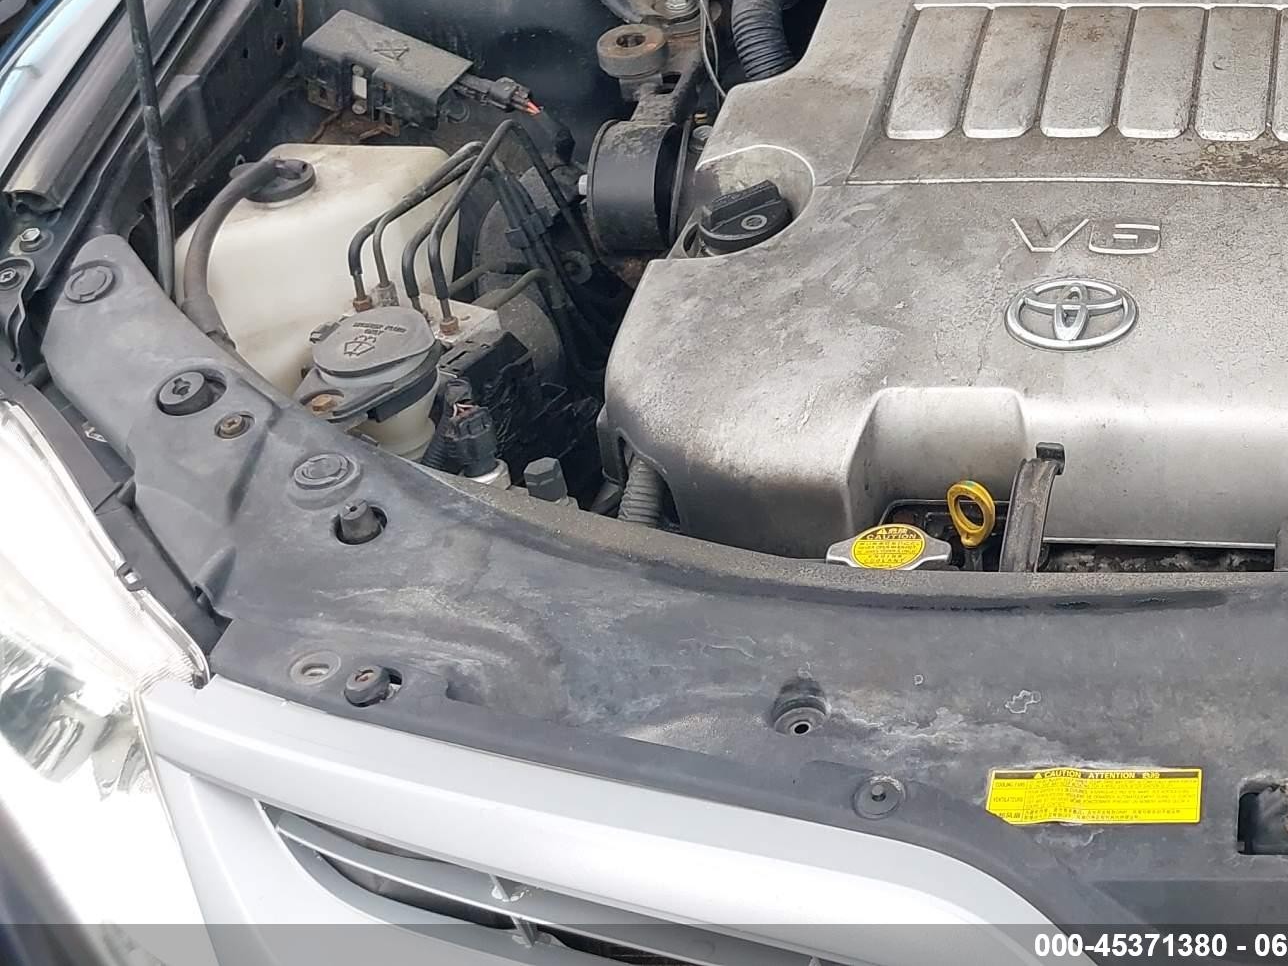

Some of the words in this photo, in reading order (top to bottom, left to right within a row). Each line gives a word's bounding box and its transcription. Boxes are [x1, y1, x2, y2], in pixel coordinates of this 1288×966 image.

[1010, 216, 1163, 255] V6
[1044, 769, 1082, 779] CAUTION
[1088, 772, 1136, 780] ATTENTION
